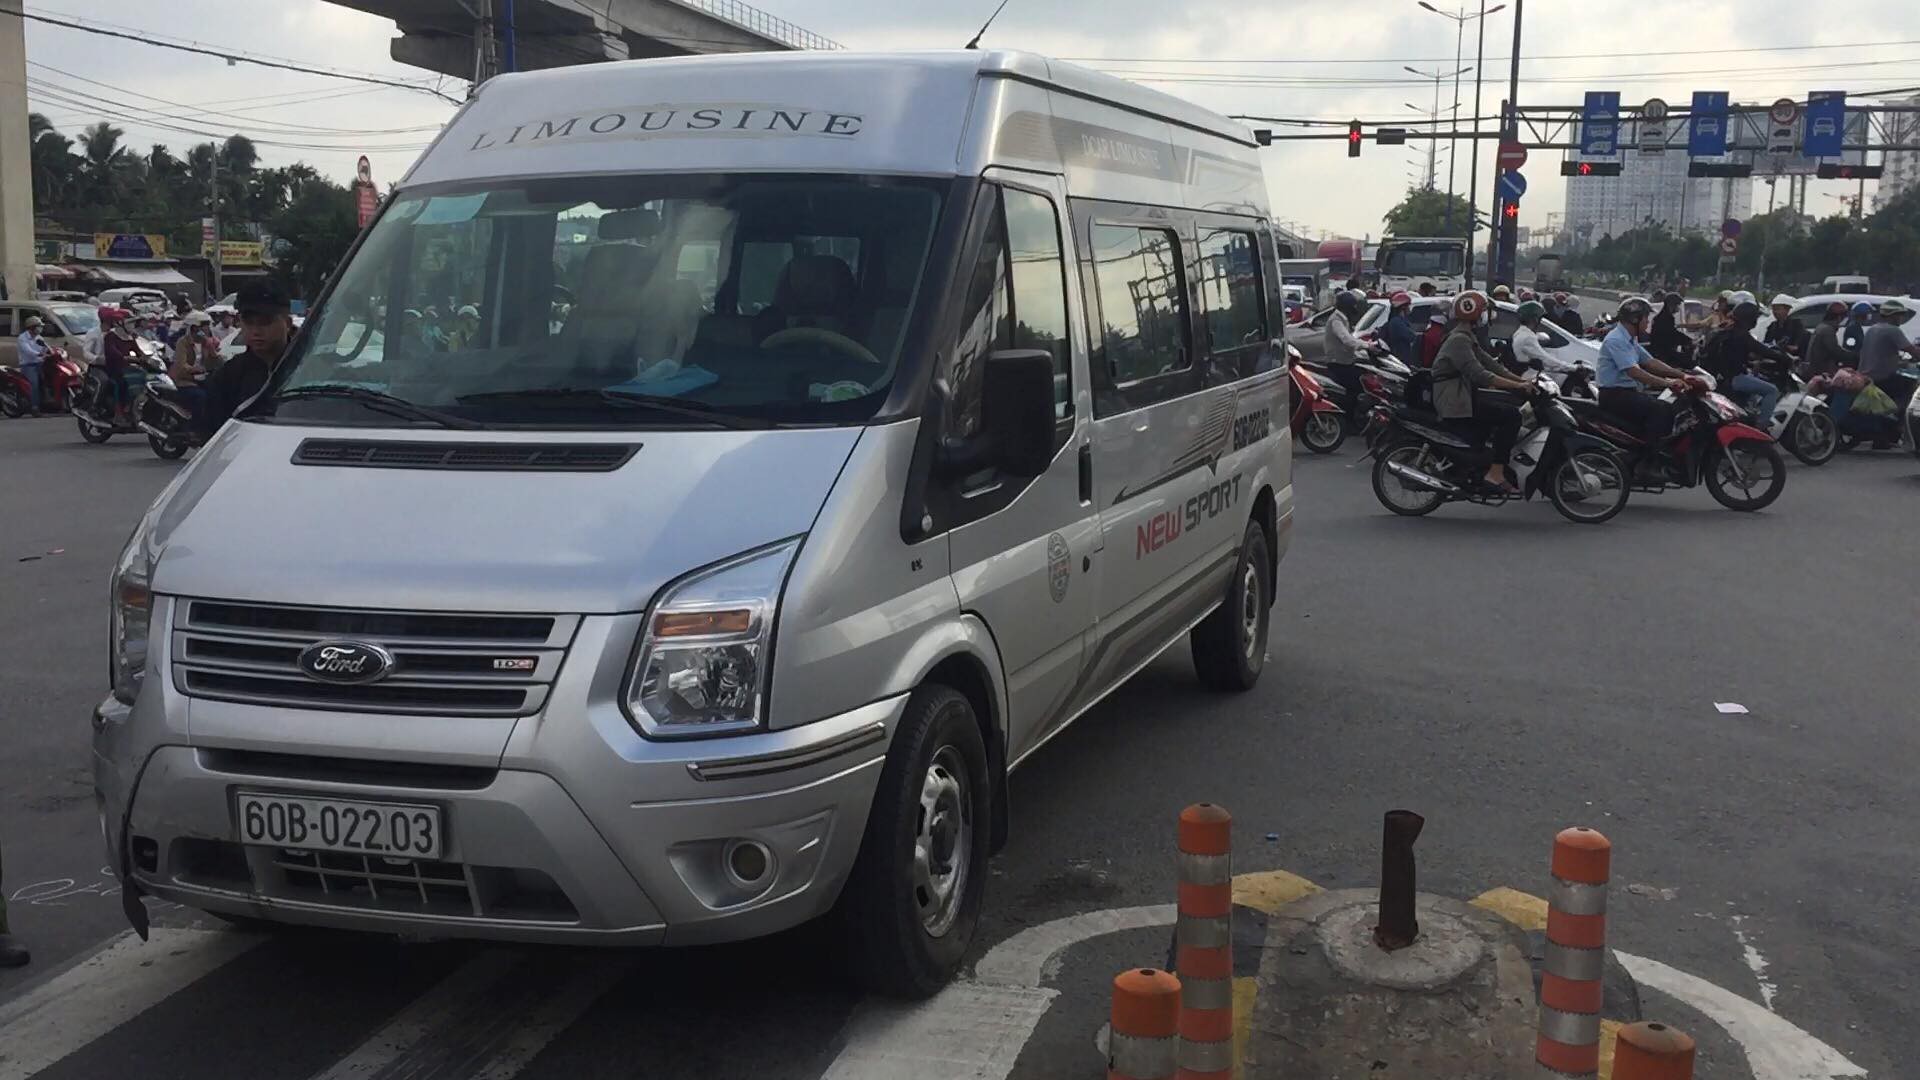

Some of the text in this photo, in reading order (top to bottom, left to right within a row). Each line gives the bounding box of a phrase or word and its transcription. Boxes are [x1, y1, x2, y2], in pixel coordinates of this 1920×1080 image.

[470, 109, 863, 151] LIMOUSINE
[1463, 300, 1473, 311] 8
[1136, 473, 1242, 560] NEW SPORT
[314, 646, 366, 673] Ford
[245, 800, 433, 853] 60B-022.03
